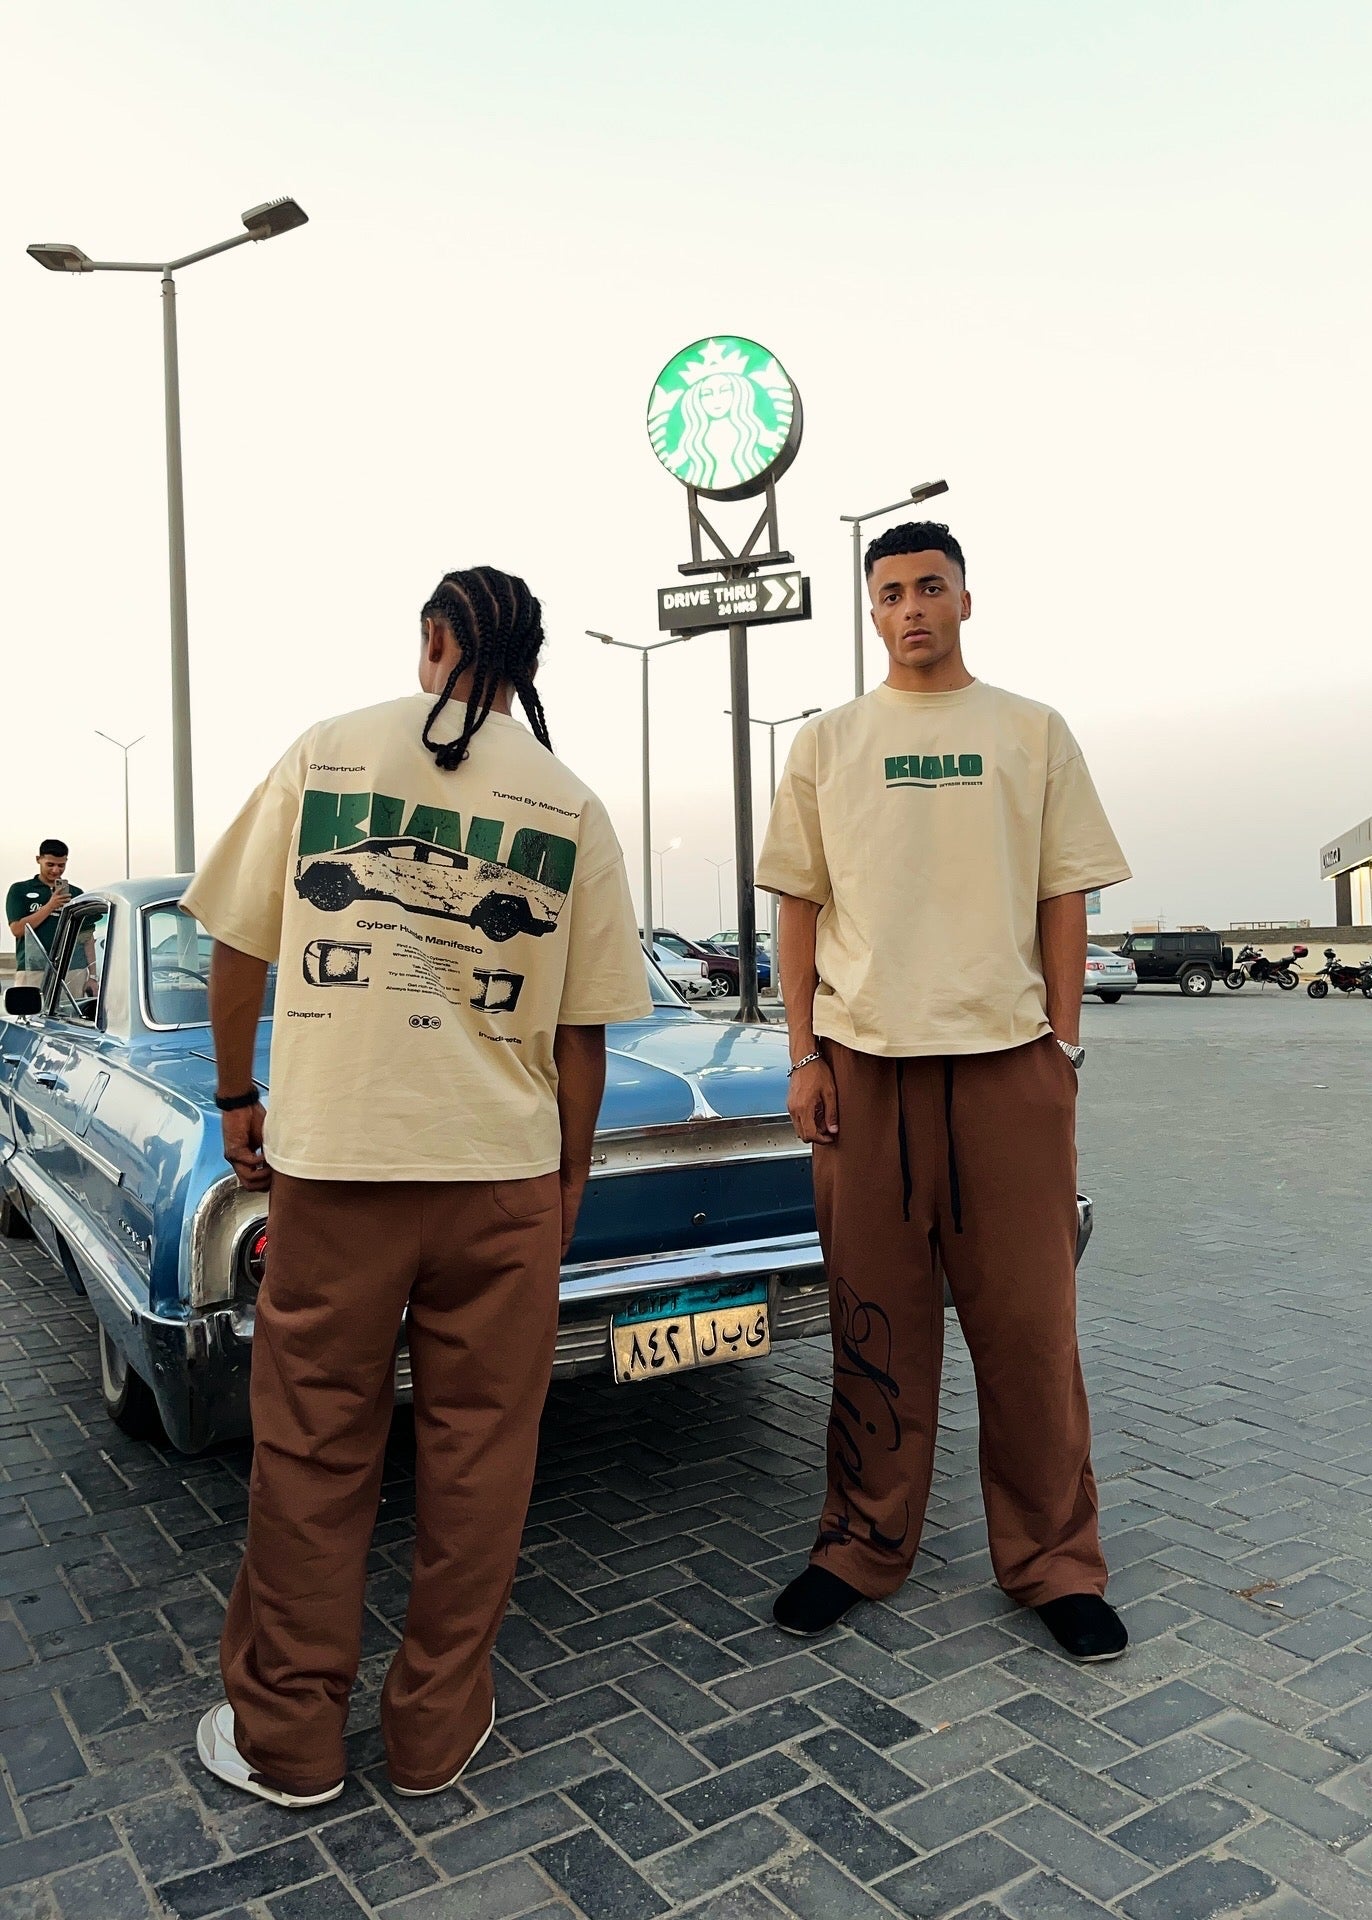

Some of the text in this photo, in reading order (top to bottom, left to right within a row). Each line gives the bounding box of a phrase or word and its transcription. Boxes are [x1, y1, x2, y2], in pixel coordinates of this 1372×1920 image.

[663, 583, 757, 610] DRIVE THRU
[718, 600, 758, 616] 24 HRS
[309, 763, 366, 772] Cybertruck
[884, 754, 983, 781] KIALO
[492, 790, 580, 819] Tuned By Mansory
[356, 919, 398, 931] Cyber
[425, 935, 483, 955] Manifesto
[286, 1010, 326, 1019] Chapter
